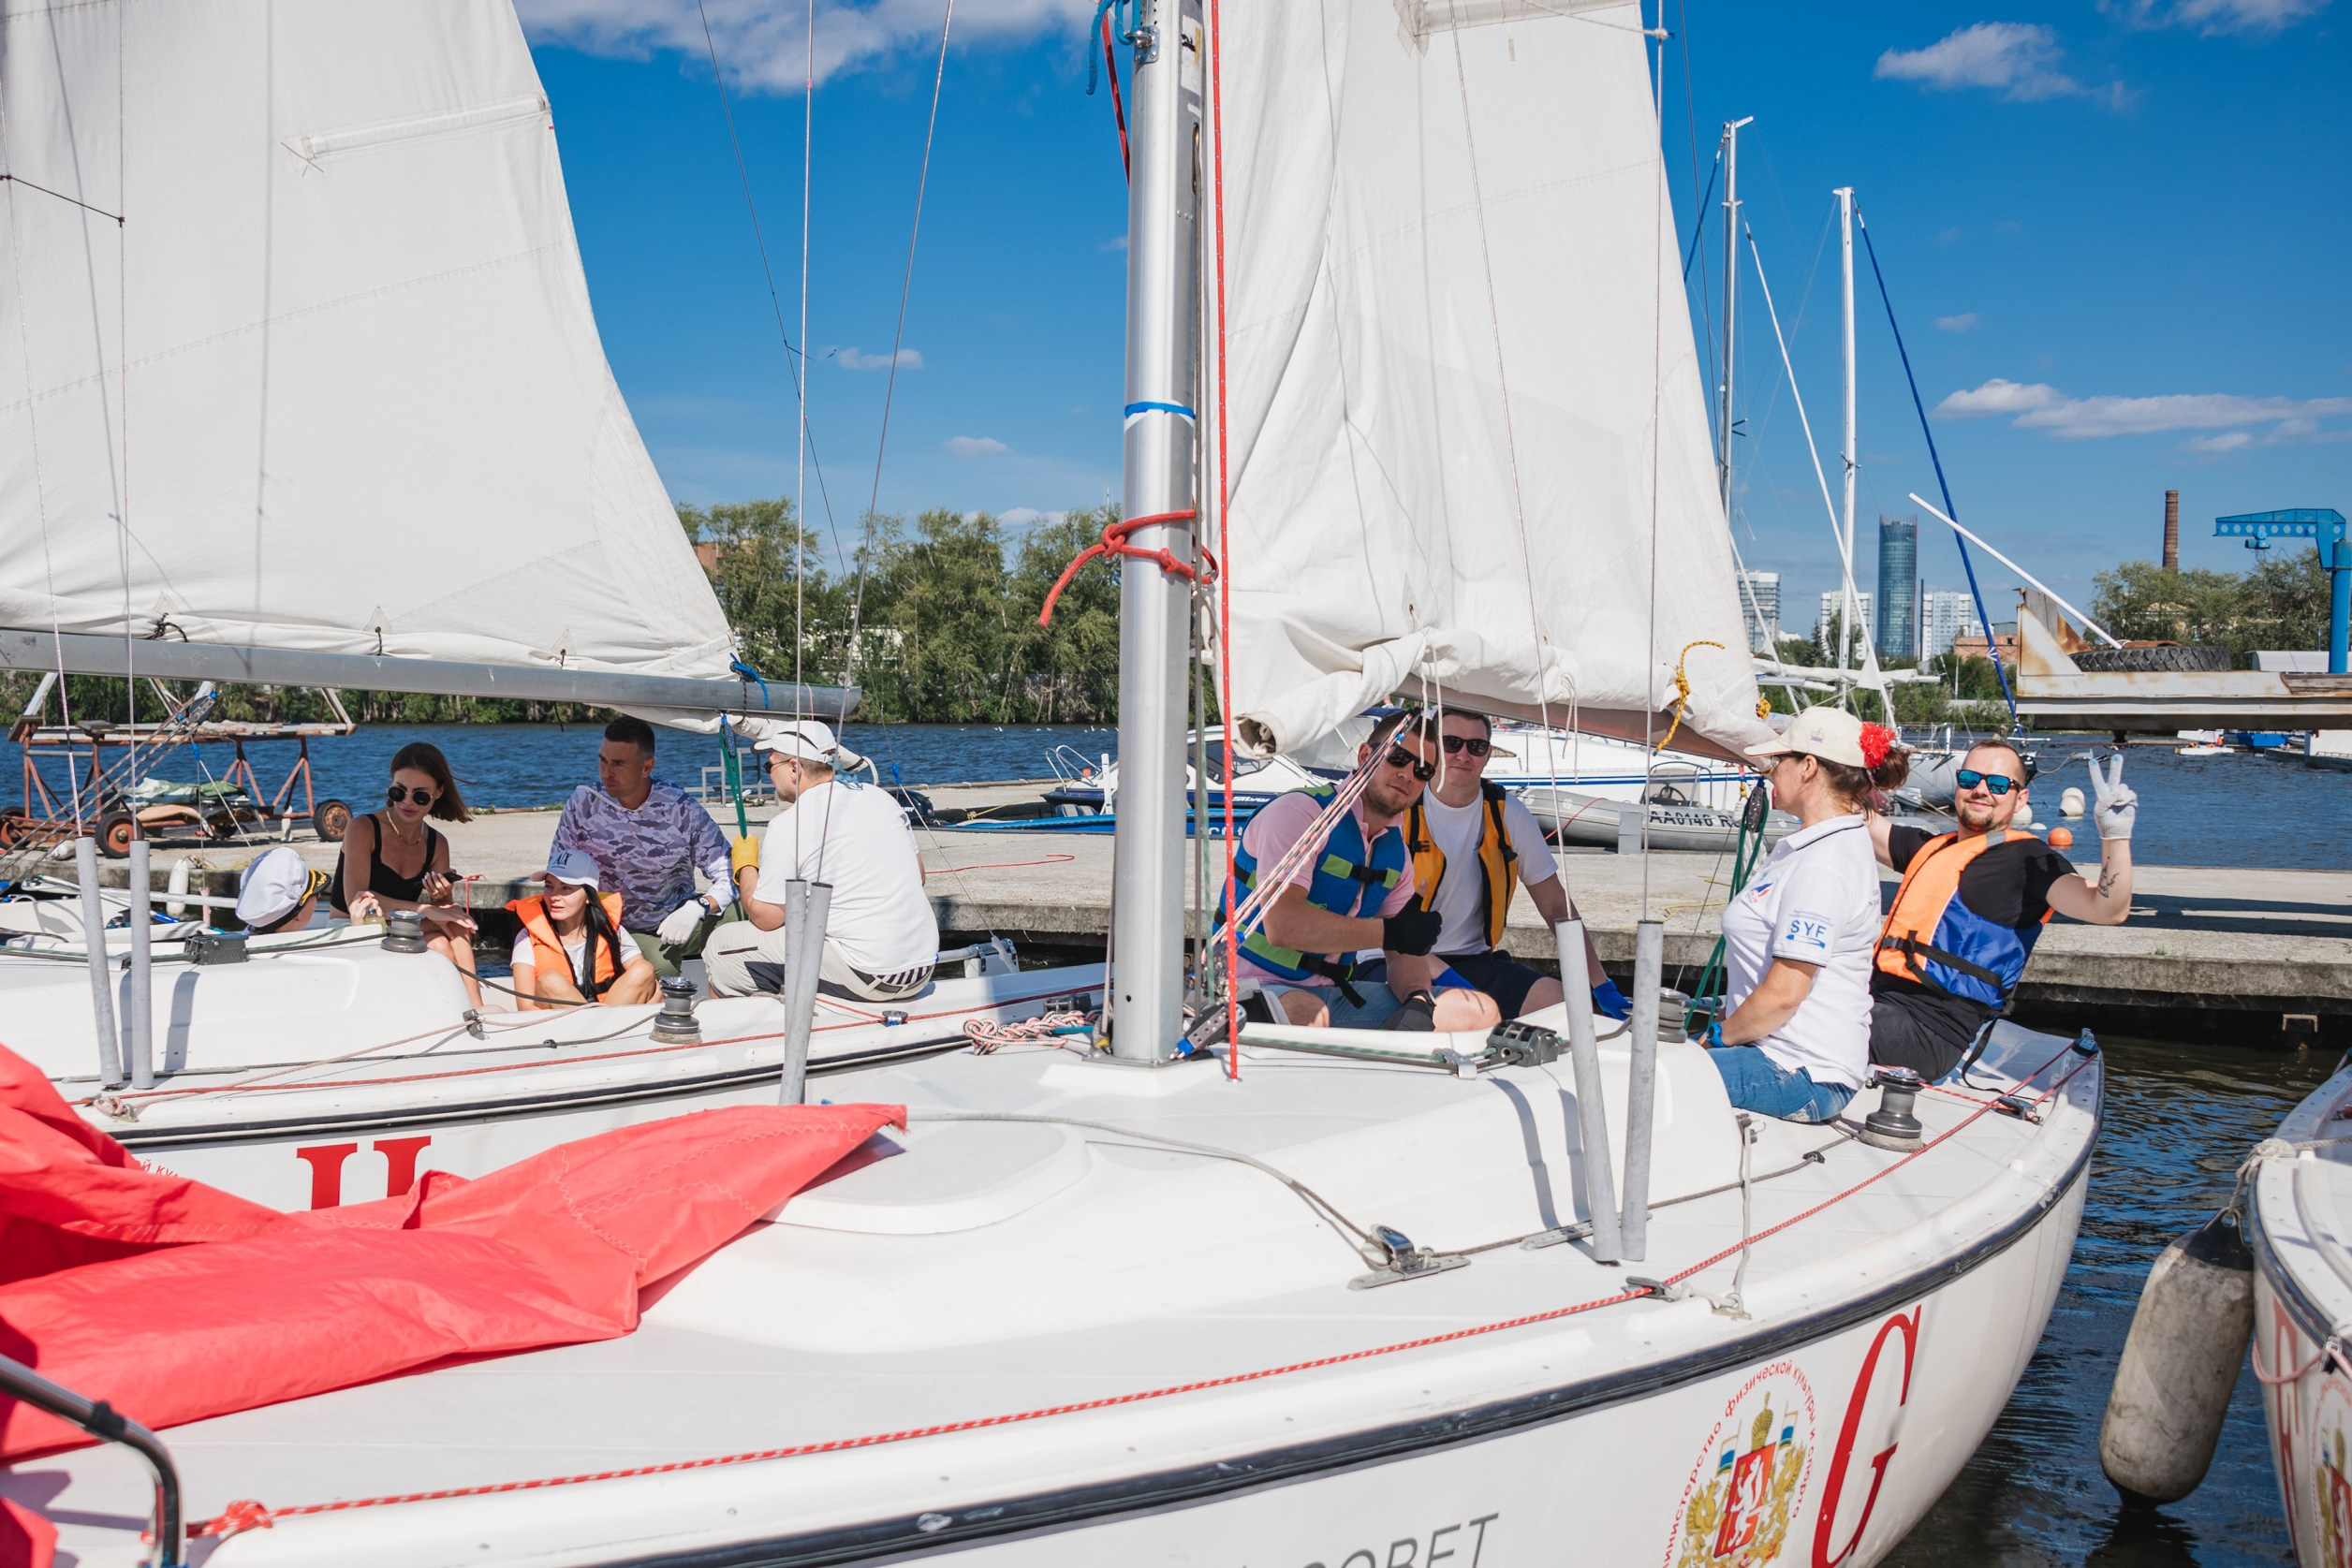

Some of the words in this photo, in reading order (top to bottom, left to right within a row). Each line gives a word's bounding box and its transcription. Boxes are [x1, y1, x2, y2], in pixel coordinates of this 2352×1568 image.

[1790, 919, 1827, 938] SYF
[1725, 1359, 1793, 1418] физической
[1792, 1366, 1816, 1424] культуры
